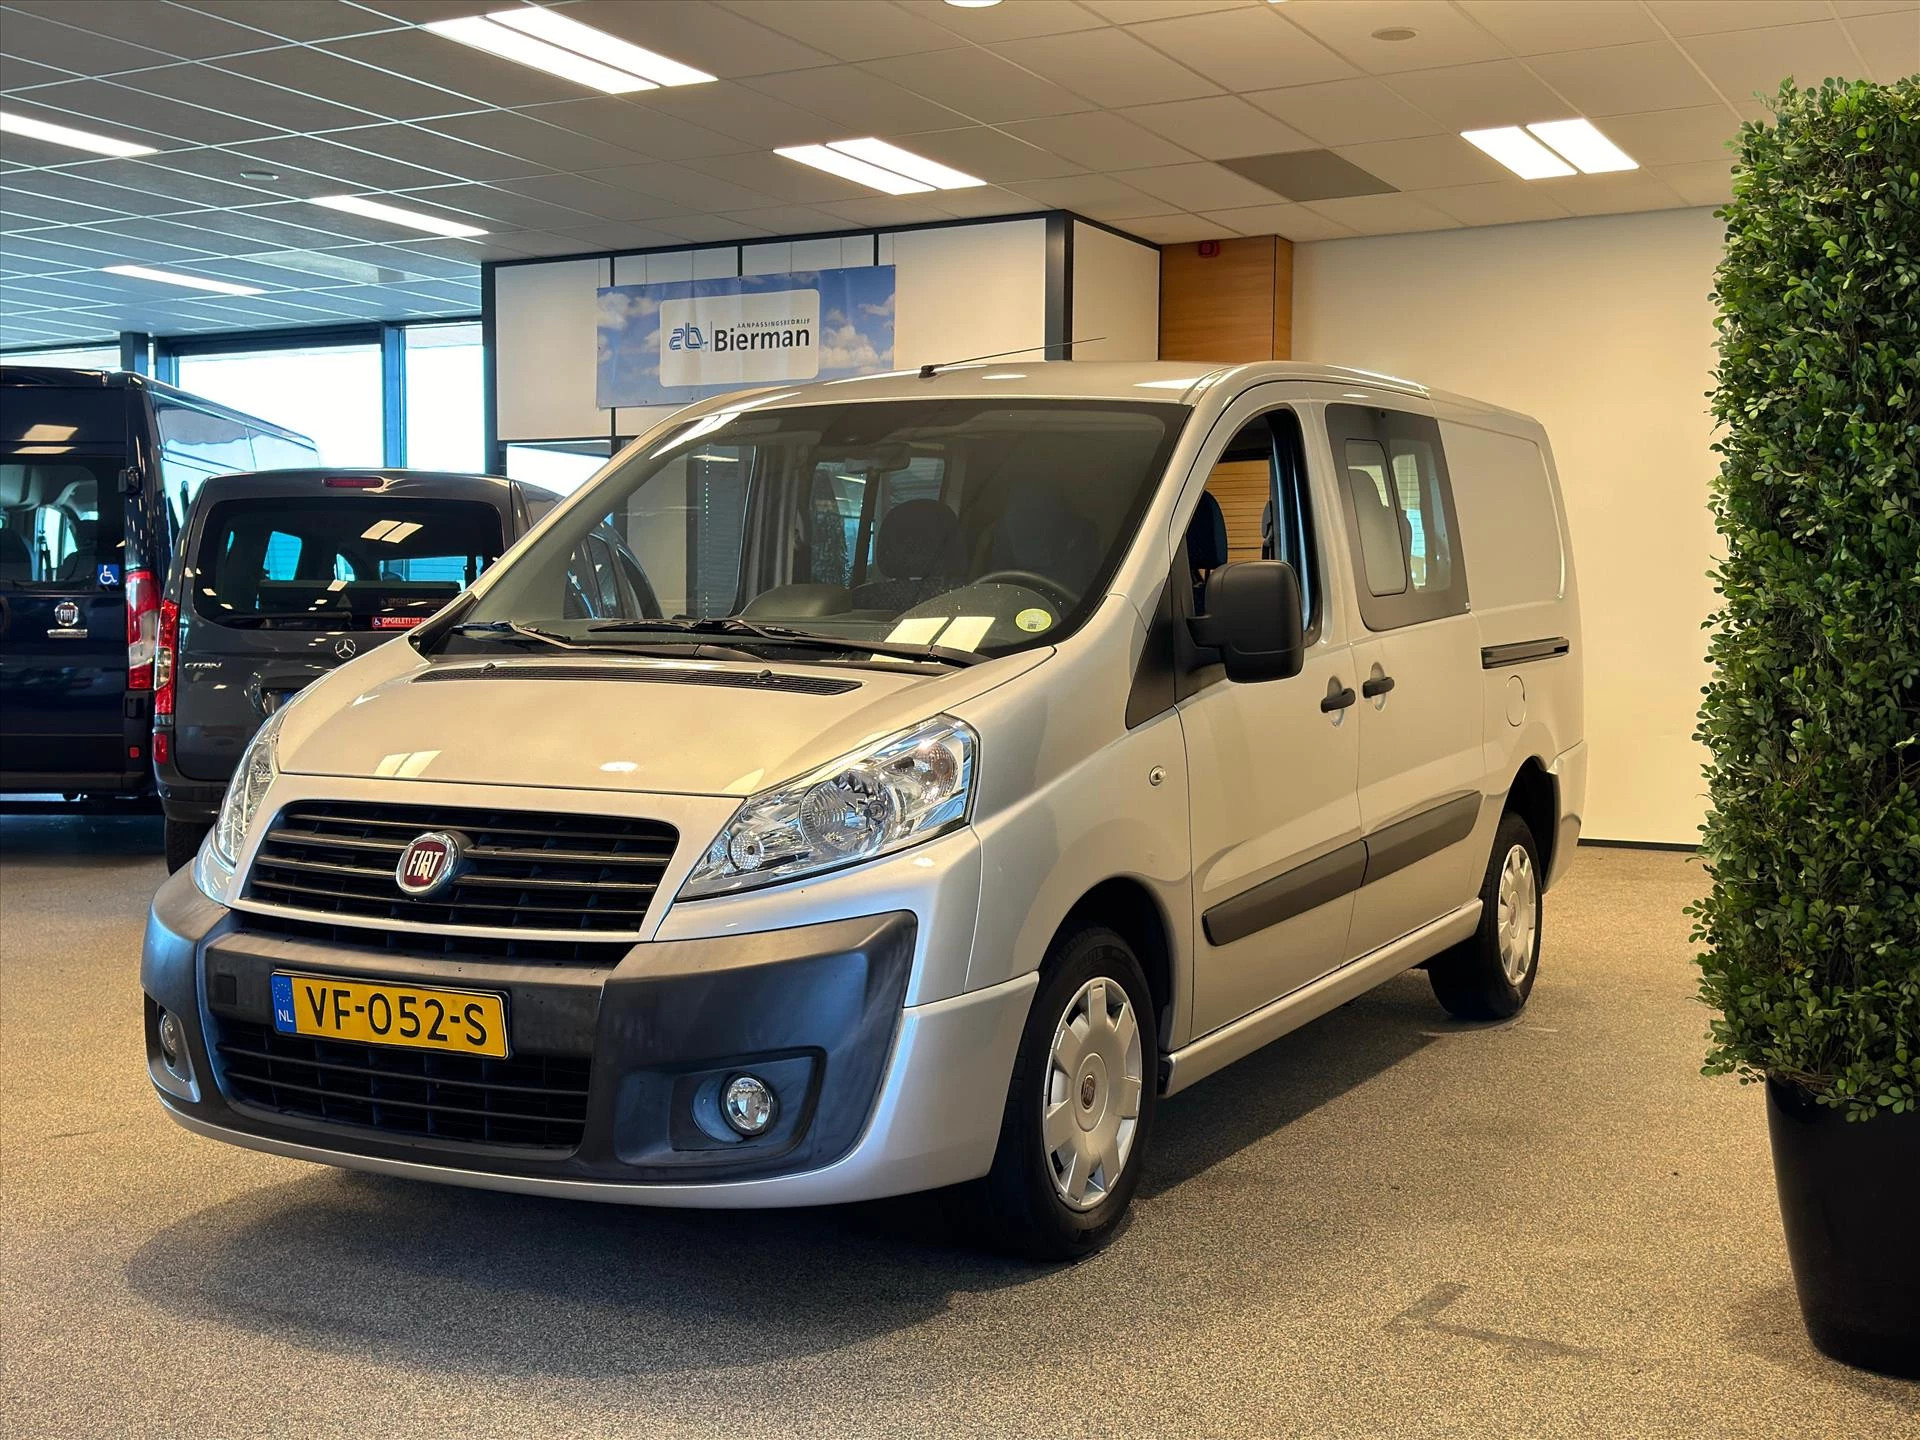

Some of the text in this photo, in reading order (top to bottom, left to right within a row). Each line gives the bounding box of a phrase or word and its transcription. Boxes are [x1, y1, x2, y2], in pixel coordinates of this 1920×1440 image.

[714, 328, 810, 352] Bierman
[406, 850, 444, 880] FIAT
[278, 986, 488, 1047] NL VF-052-S
